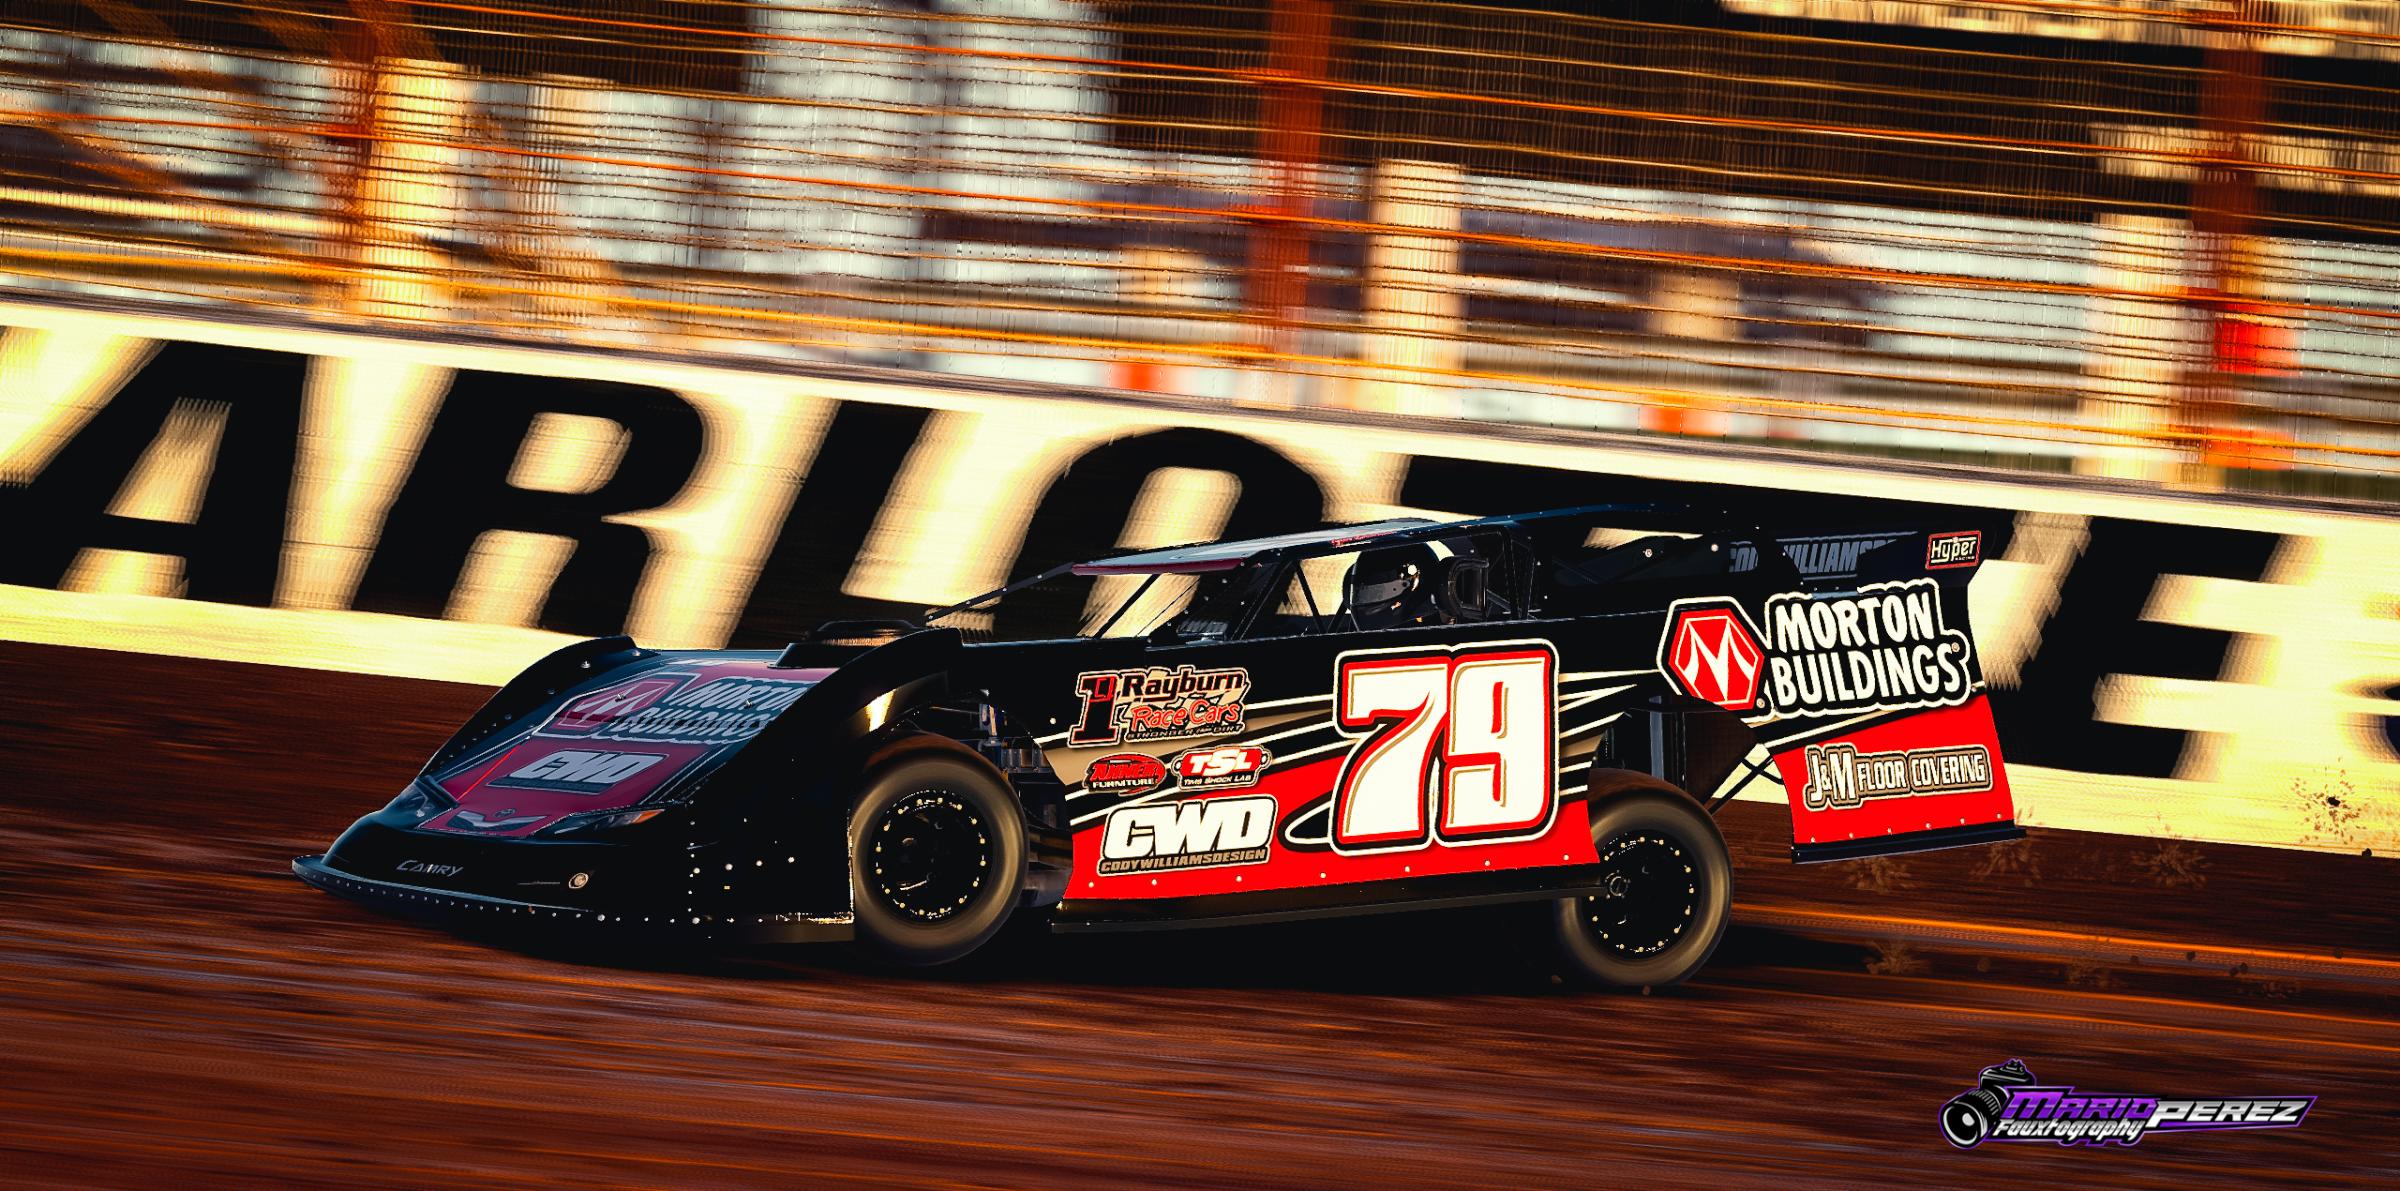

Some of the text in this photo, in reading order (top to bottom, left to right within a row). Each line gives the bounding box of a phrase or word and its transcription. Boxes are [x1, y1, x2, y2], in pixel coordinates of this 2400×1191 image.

[1931, 539, 1976, 562] Hyper
[1775, 592, 1935, 653] MORTON
[667, 681, 810, 713] MORTO
[1121, 669, 1244, 703] Rayburn
[1131, 698, 1241, 732] Race Cars
[1189, 747, 1253, 777] TSL
[1342, 650, 1552, 845] 79
[509, 750, 665, 785] CWD
[1092, 778, 1155, 789] FURNITURE
[1810, 752, 1986, 802] J&M FLOOR COVERING
[1103, 798, 1275, 860] CWD
[1101, 849, 1266, 873] CODYWILLIAMSDESIGN
